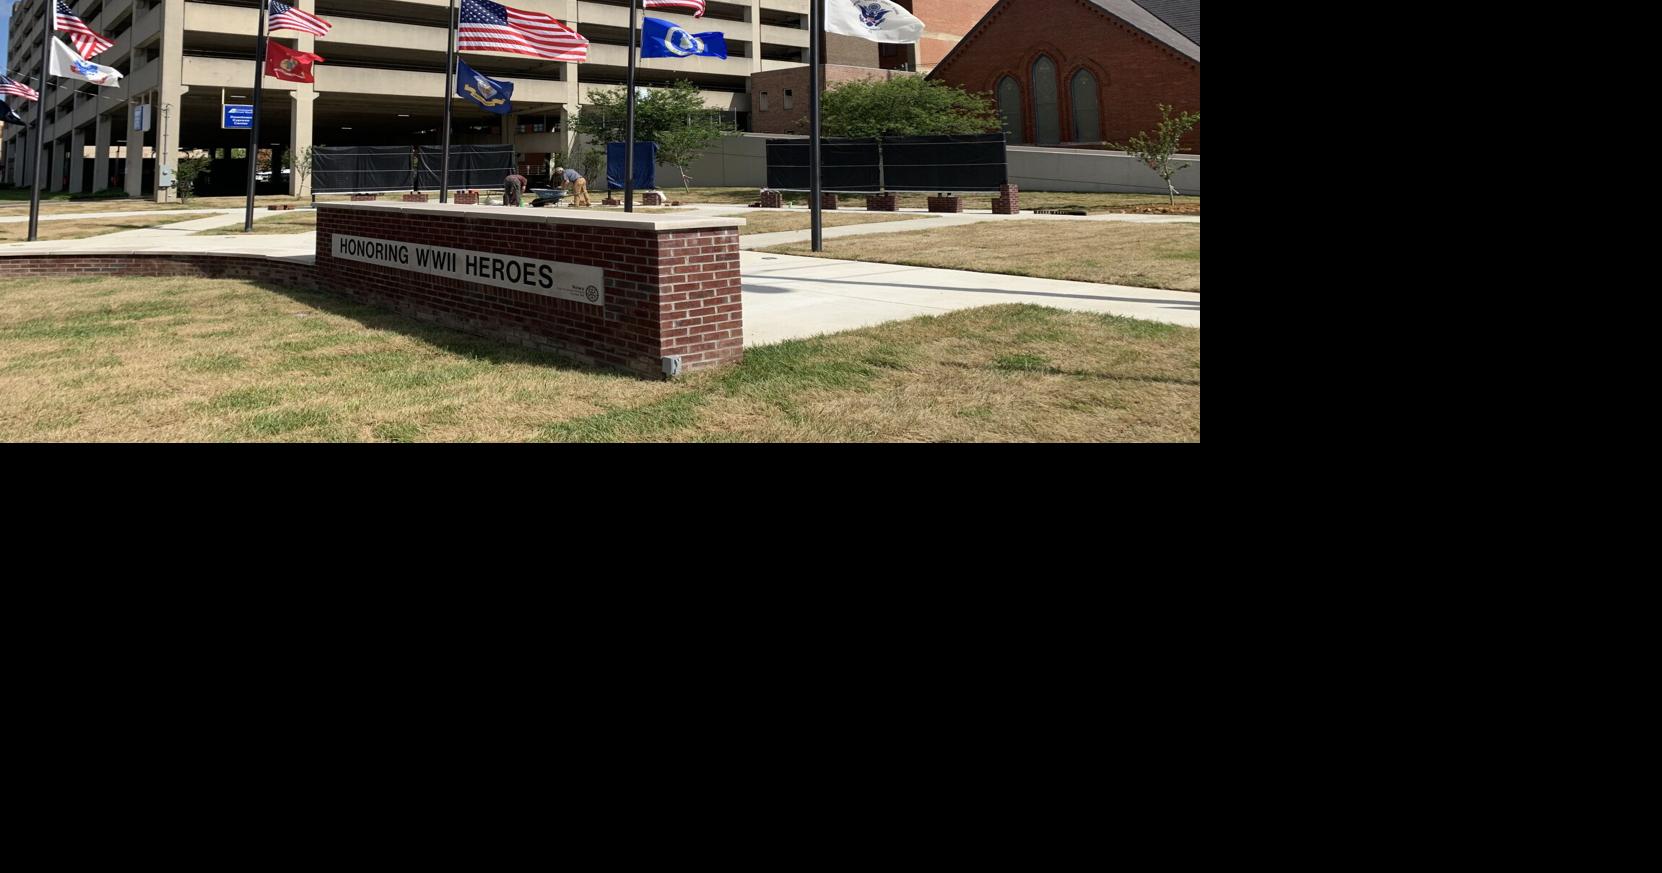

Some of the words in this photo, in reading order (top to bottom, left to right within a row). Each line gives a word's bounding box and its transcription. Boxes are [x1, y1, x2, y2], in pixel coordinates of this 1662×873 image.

[339, 237, 409, 265] HONORING
[415, 247, 456, 273] WWII
[465, 254, 554, 289] HEROES
